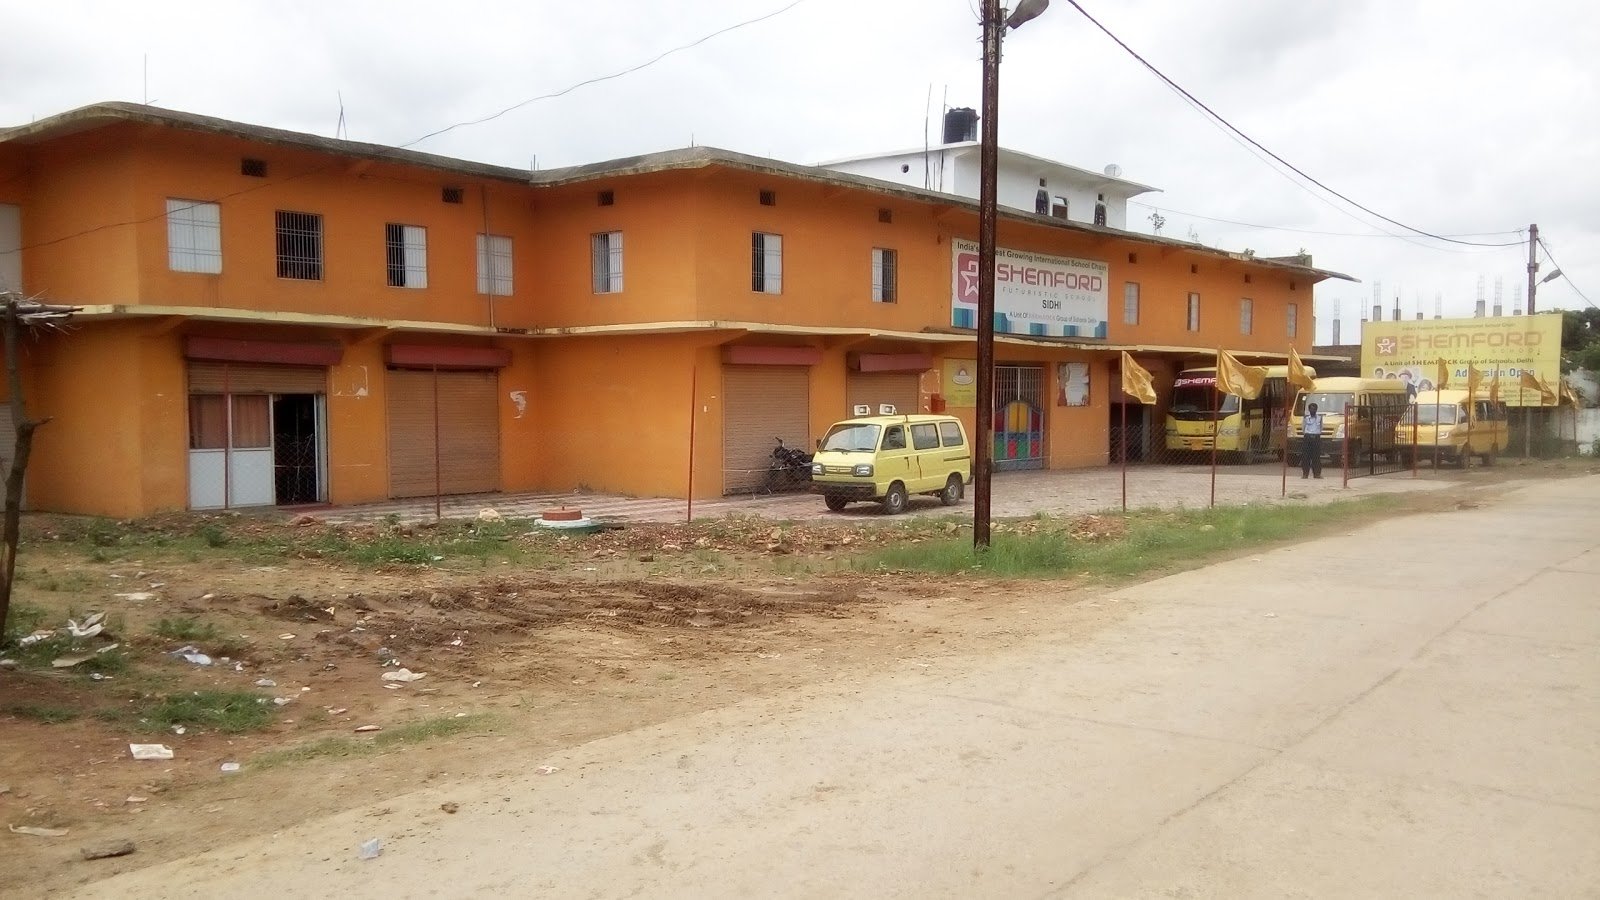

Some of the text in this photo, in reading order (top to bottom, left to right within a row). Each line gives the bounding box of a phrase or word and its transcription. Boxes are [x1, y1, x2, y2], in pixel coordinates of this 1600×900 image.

[957, 241, 979, 252] India's
[1006, 250, 1033, 262] Growing
[1034, 255, 1070, 265] International
[1071, 260, 1090, 269] School
[1091, 263, 1107, 271] Chain
[996, 263, 1102, 292] SHEMFORD
[1002, 286, 1058, 298] FUTURISTIC
[1042, 299, 1062, 310] SIDHI
[1400, 331, 1542, 349] SHEMFORD
[1509, 368, 1535, 378] Opn
